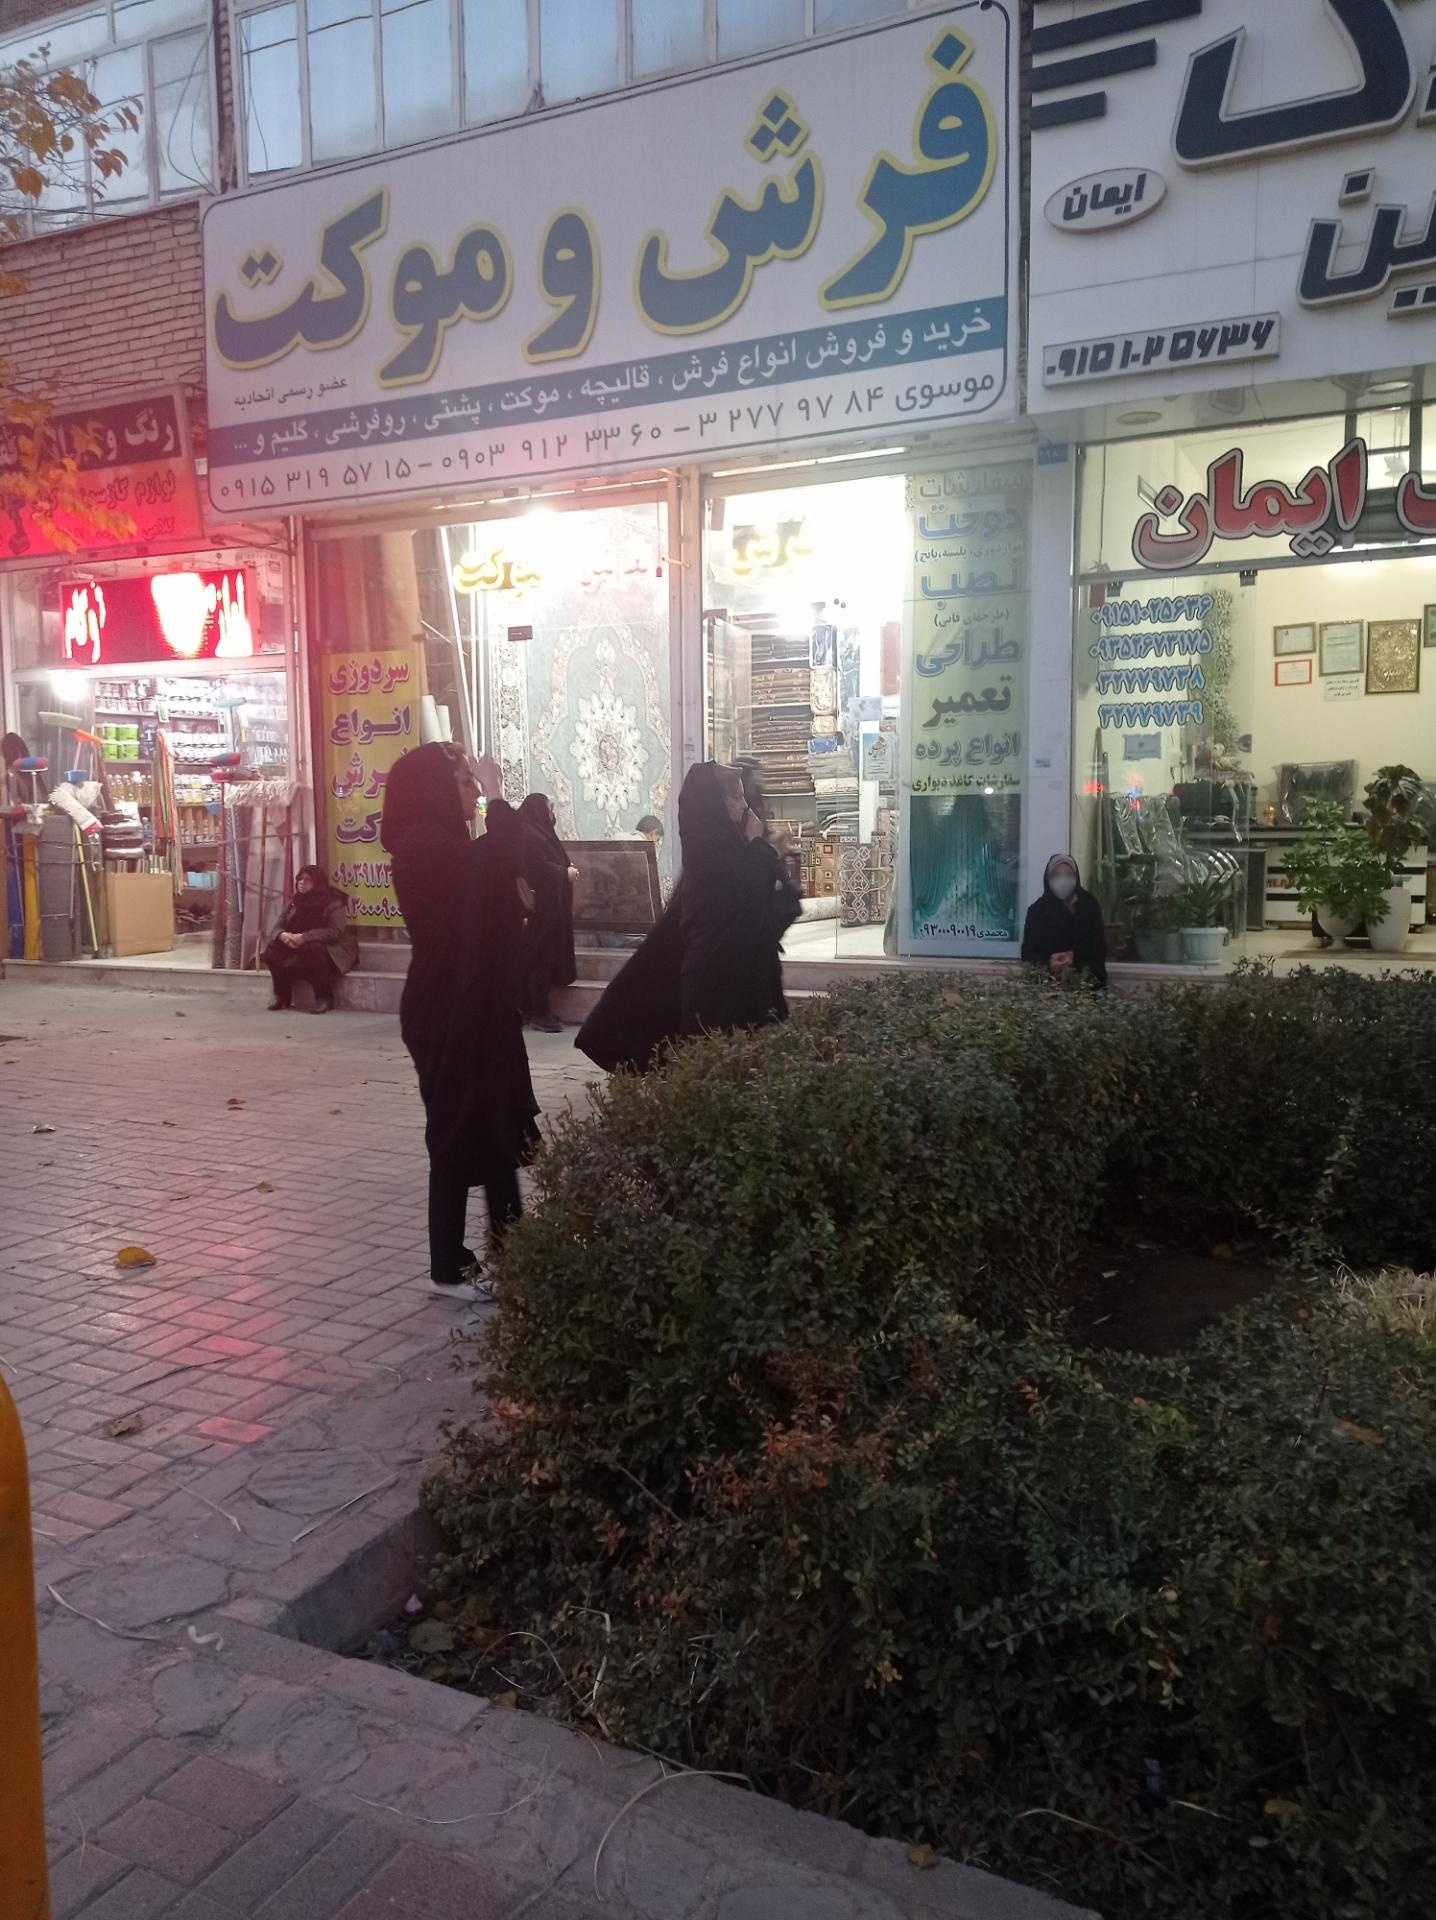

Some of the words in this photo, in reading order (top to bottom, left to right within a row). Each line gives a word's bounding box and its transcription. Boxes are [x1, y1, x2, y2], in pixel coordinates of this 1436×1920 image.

[634, 25, 996, 337] فرش
[1063, 173, 1147, 221] ایمان
[212, 186, 514, 389] موکت
[522, 206, 600, 363] و
[806, 322, 886, 370] فروش
[895, 327, 913, 356] و
[923, 306, 991, 349] خرید
[671, 350, 728, 391] فرش
[737, 338, 796, 385] انواع
[233, 386, 275, 411] اتحادیه
[278, 386, 313, 403] رسمی
[318, 376, 348, 397] عضو
[500, 386, 559, 414] موکت
[580, 363, 650, 405] قالیچه
[896, 374, 994, 412] موسوی
[124, 407, 176, 452] رنگ
[325, 407, 406, 445] روفرشی
[424, 393, 481, 430] پشتی
[105, 428, 118, 461] و
[253, 432, 265, 454] و
[271, 419, 307, 455] گلیم
[918, 502, 1024, 540] دوخت
[1132, 438, 1367, 570] ایمان
[919, 557, 1018, 609] نصب
[1090, 593, 1214, 627] ۰۹۱۵۱۰۲۵۶۳۶
[915, 628, 1020, 677] طراحی
[328, 657, 410, 694] سردوزی
[922, 675, 1012, 728] تعمیر
[330, 705, 411, 744] انواع
[914, 738, 961, 766] پرده
[965, 732, 1021, 765] انواع
